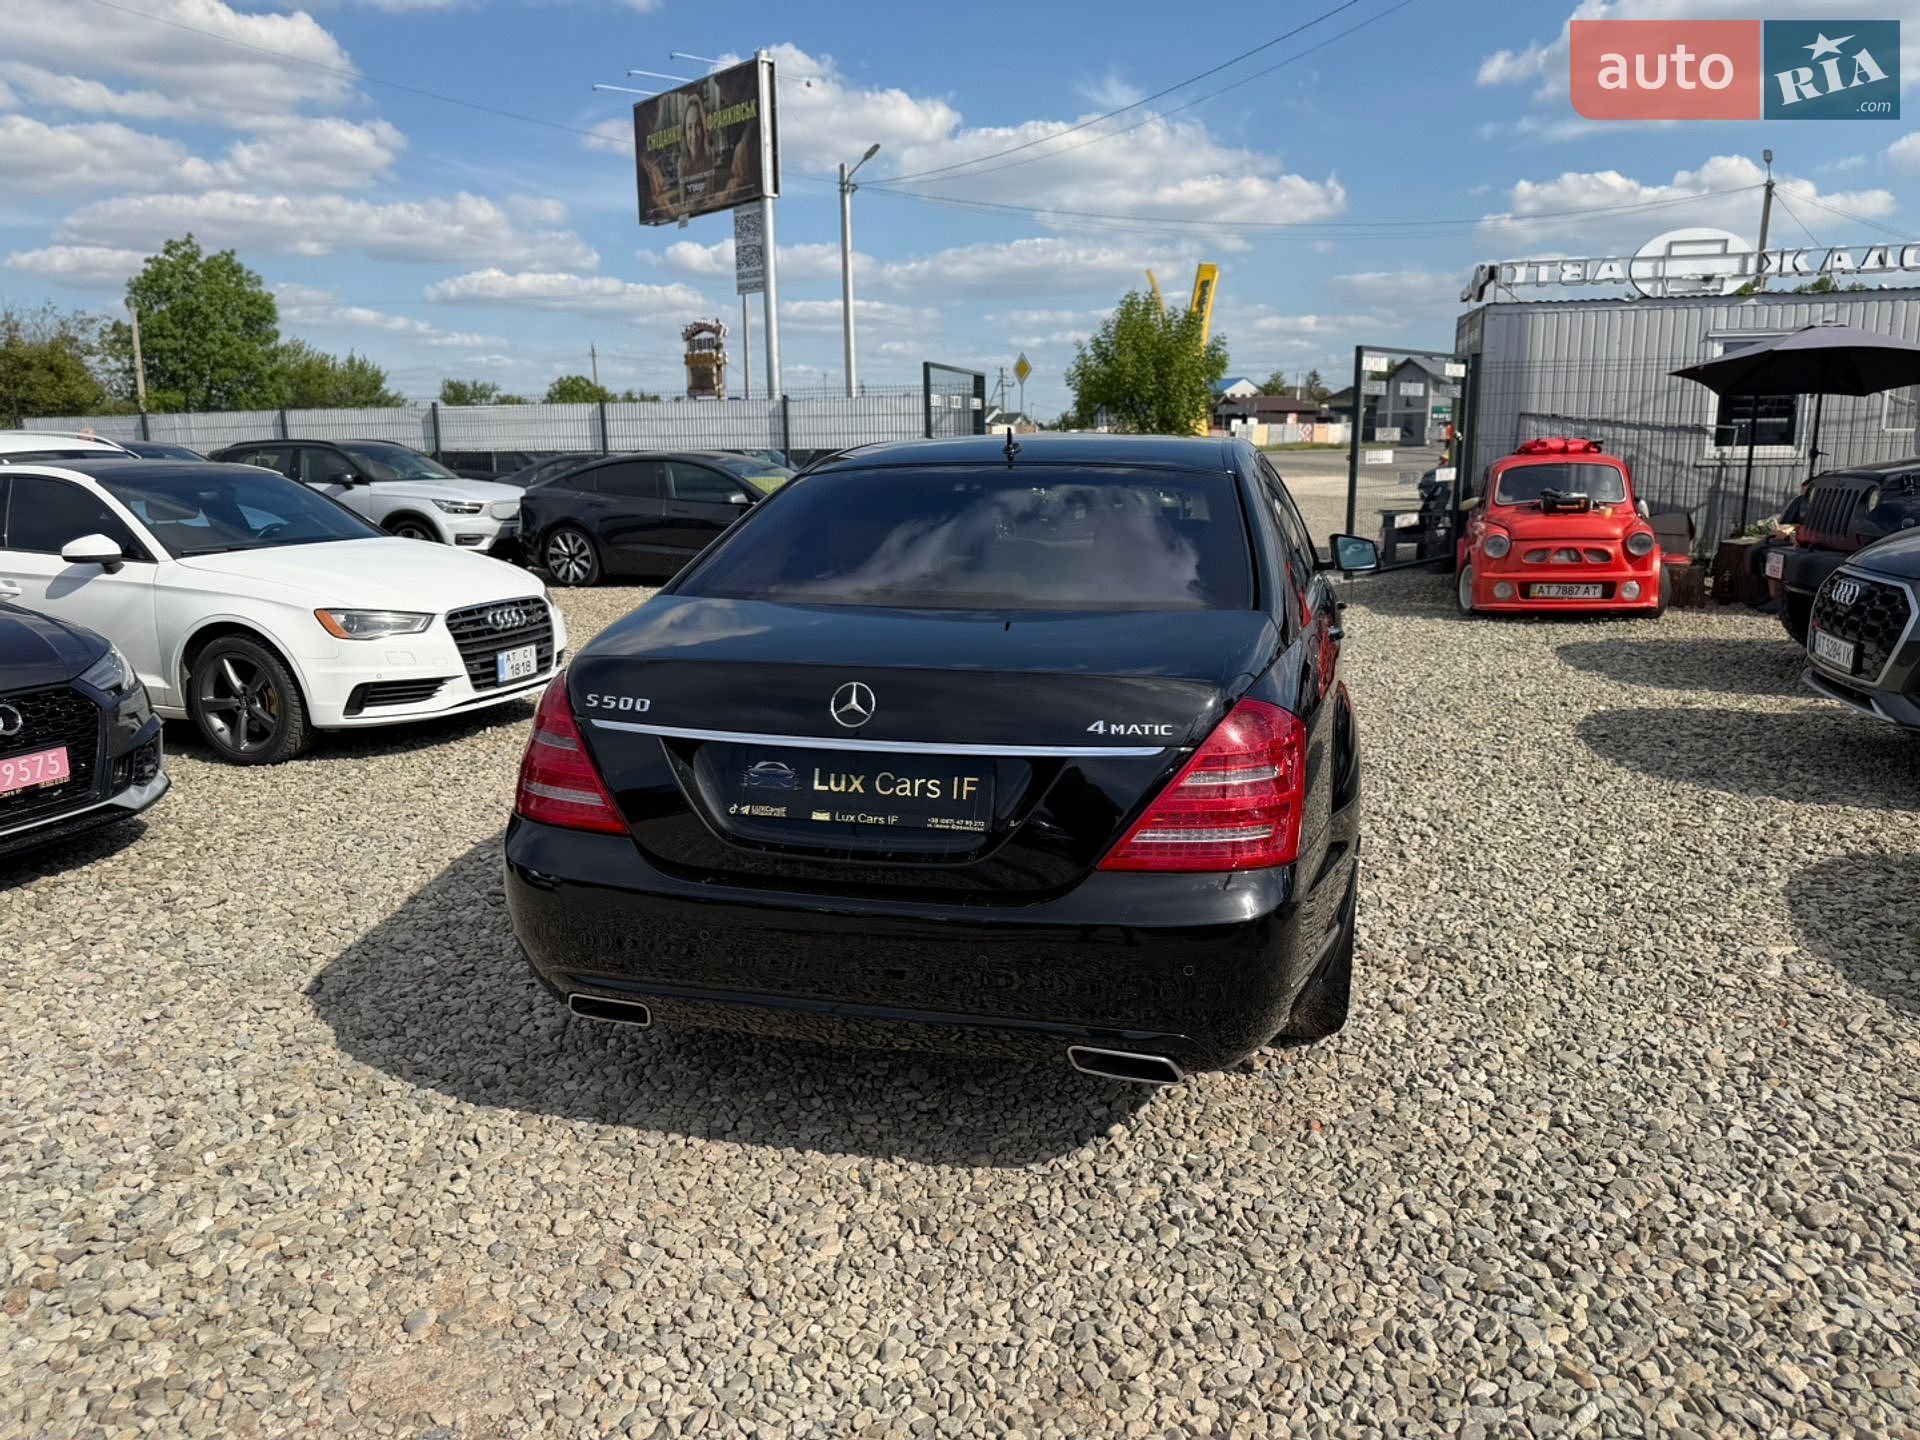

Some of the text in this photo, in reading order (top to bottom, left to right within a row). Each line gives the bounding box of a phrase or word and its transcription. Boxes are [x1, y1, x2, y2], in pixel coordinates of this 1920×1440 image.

[1537, 585, 1554, 595] AT
[510, 660, 531, 677] 1818
[2, 751, 61, 786] 9575
[813, 767, 980, 800] Lux Cars IF
[835, 811, 900, 825] Lux Cars IF
